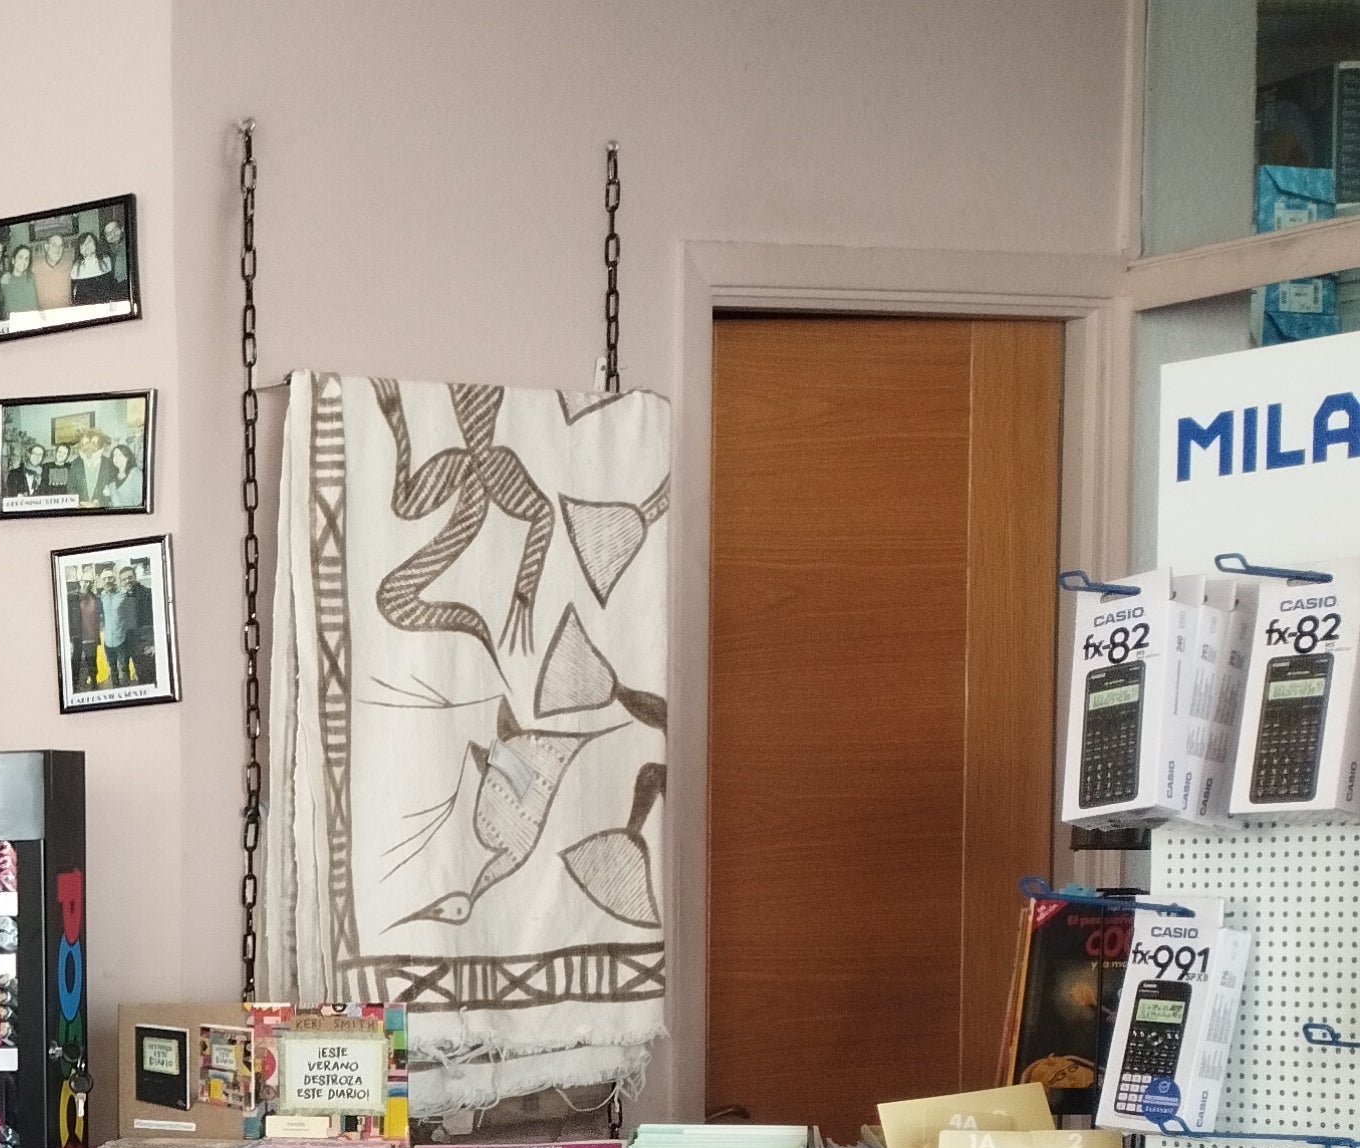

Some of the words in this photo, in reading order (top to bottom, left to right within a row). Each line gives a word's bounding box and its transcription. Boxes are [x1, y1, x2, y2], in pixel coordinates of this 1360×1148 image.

[1176, 391, 1360, 483] MILA
[1093, 606, 1145, 627] CASIO
[1280, 595, 1337, 612] CASIO
[1083, 622, 1150, 664] fx-82
[1266, 613, 1341, 654] fx-82
[1166, 760, 1175, 798] CASIO
[1346, 762, 1357, 802] CASIO
[1200, 778, 1213, 816] CASIO
[1151, 927, 1198, 939] CASIO
[1132, 942, 1210, 980] fx-991
[296, 1019, 322, 1030] KERI
[333, 1019, 375, 1030] SMITH
[303, 1074, 362, 1085] DESTROZA
[308, 1060, 359, 1072] VERANO
[297, 1088, 323, 1099] ESTE
[949, 1113, 978, 1130] 4A
[1196, 1091, 1208, 1127] CASIO
